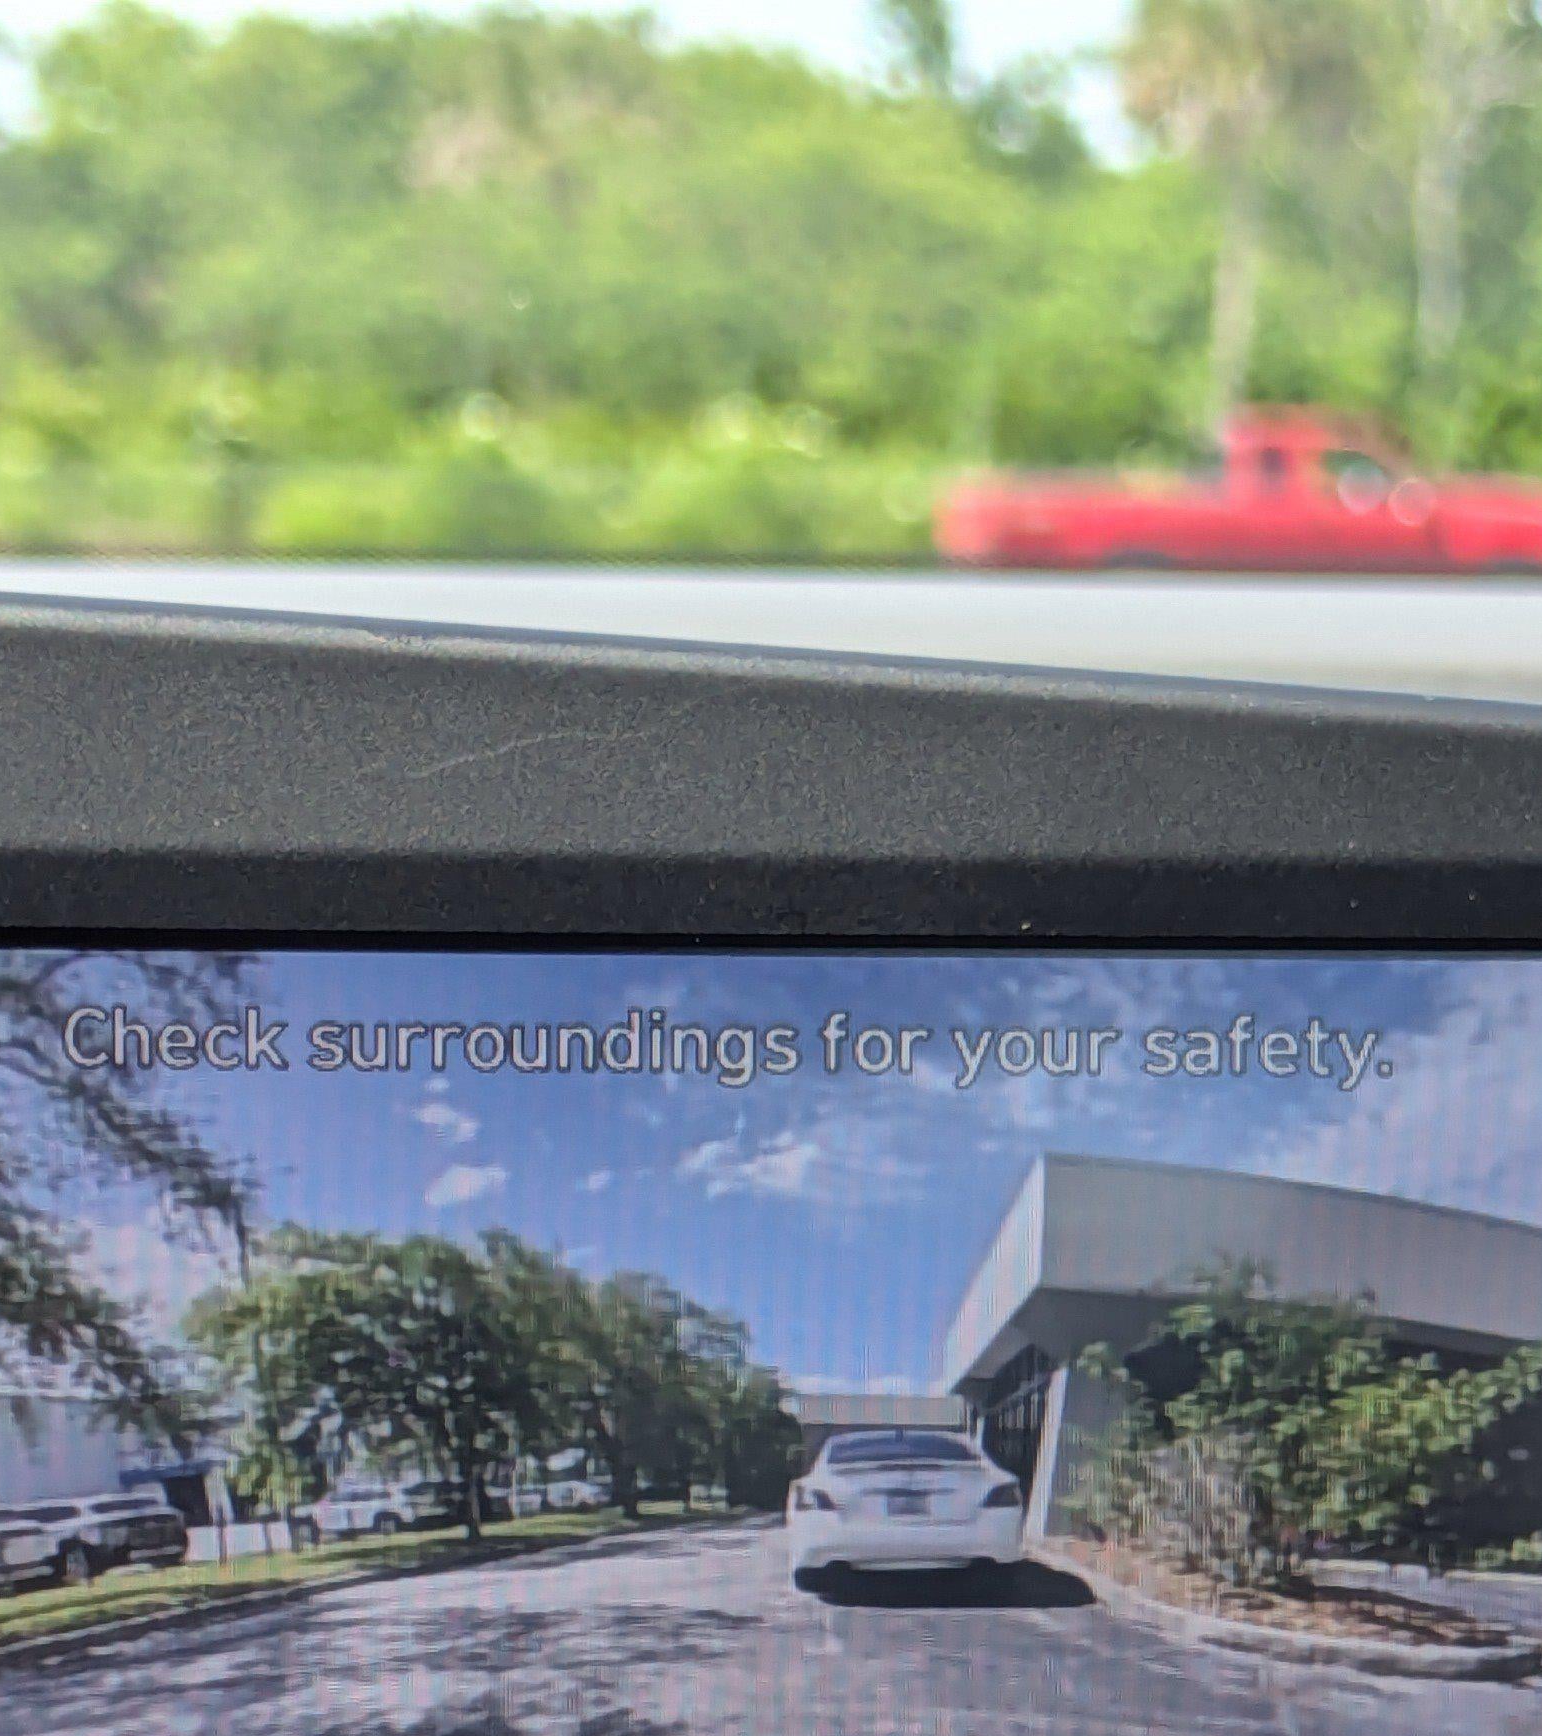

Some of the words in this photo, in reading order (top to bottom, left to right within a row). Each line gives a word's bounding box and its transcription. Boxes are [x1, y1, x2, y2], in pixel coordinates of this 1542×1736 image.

[63, 1005, 287, 1070] Check
[309, 1008, 799, 1086] surroundings
[823, 1012, 930, 1074] for
[955, 1027, 1119, 1088] your
[1145, 1014, 1393, 1090] safety.
